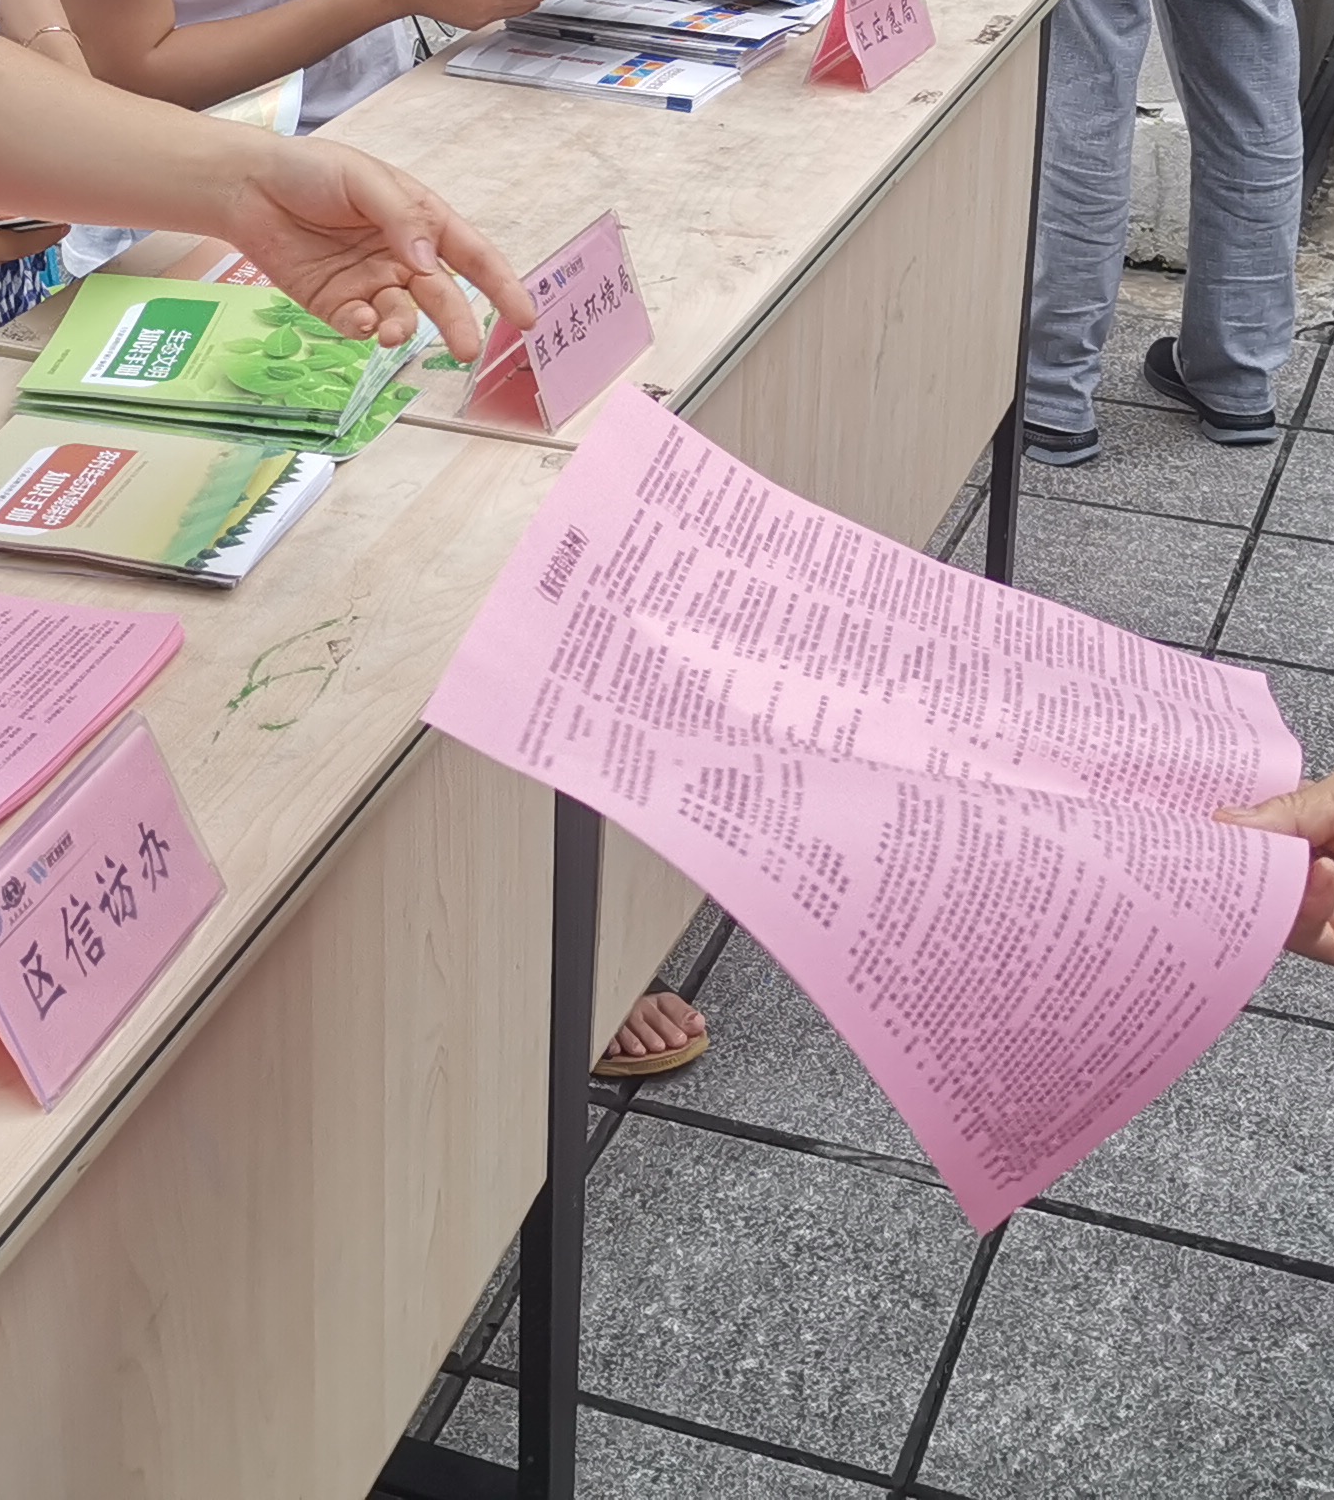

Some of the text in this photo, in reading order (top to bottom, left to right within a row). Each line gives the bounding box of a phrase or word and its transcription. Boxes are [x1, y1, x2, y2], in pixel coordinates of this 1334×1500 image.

[534, 263, 635, 371] 区生态环境局
[114, 328, 165, 377] 知识手册
[143, 328, 192, 378] 生态文明
[5, 470, 71, 522] 知识手册
[41, 450, 121, 526] 农村生态环境保护
[19, 821, 171, 1021] 区信访办
